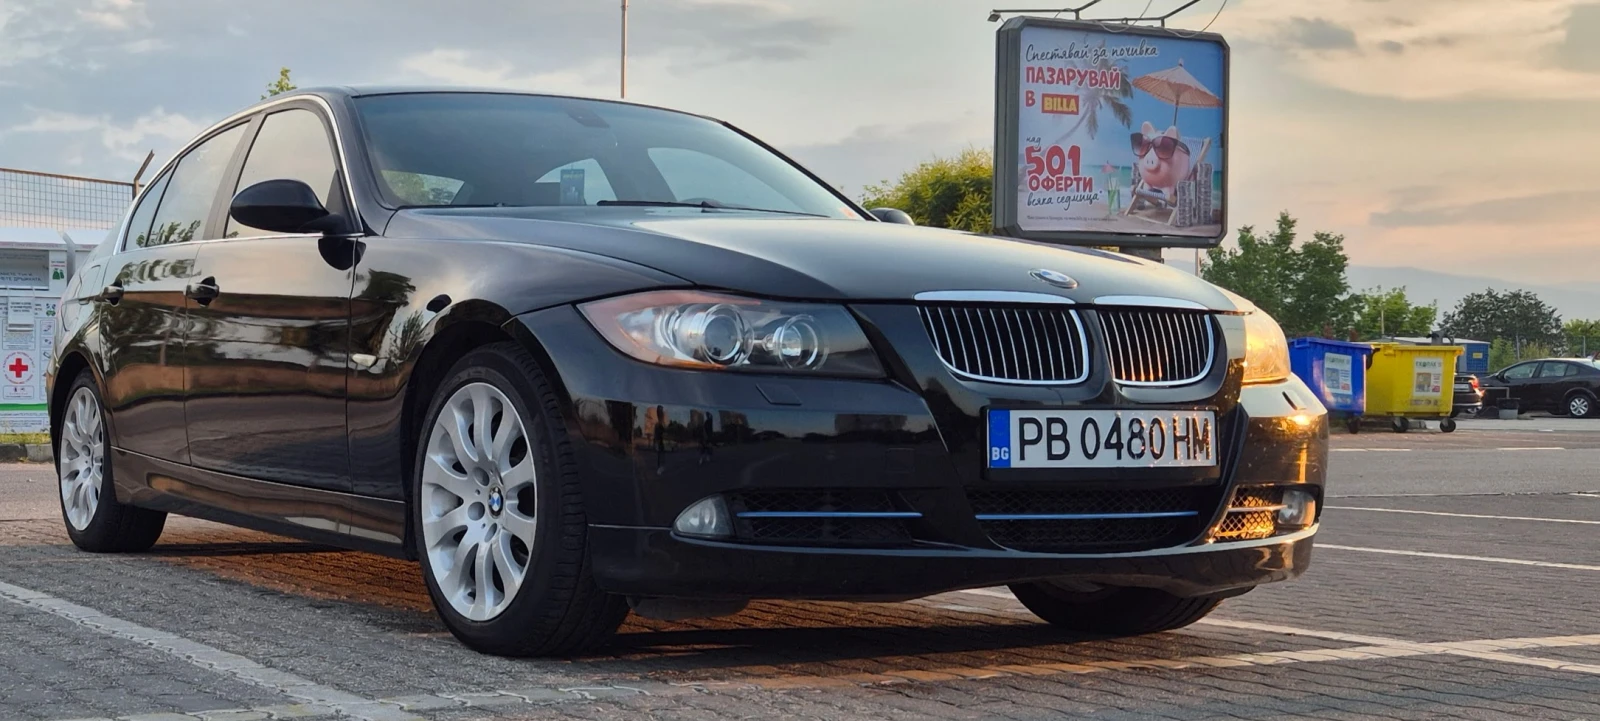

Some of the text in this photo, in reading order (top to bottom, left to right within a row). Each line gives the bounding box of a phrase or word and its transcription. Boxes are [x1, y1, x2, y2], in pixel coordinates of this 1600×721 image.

[1026, 40, 1158, 64] Спестявай за почивка
[1026, 66, 1120, 88] ПАЗАРУВАЙ
[1026, 90, 1077, 112] В BILLA
[1026, 136, 1041, 148] над
[1025, 145, 1080, 177] 501
[1028, 175, 1093, 193] ОФЕРТИ
[1027, 192, 1053, 207] всяка
[1018, 416, 1212, 461] PB 0480 HM
[991, 446, 1009, 461] BG
